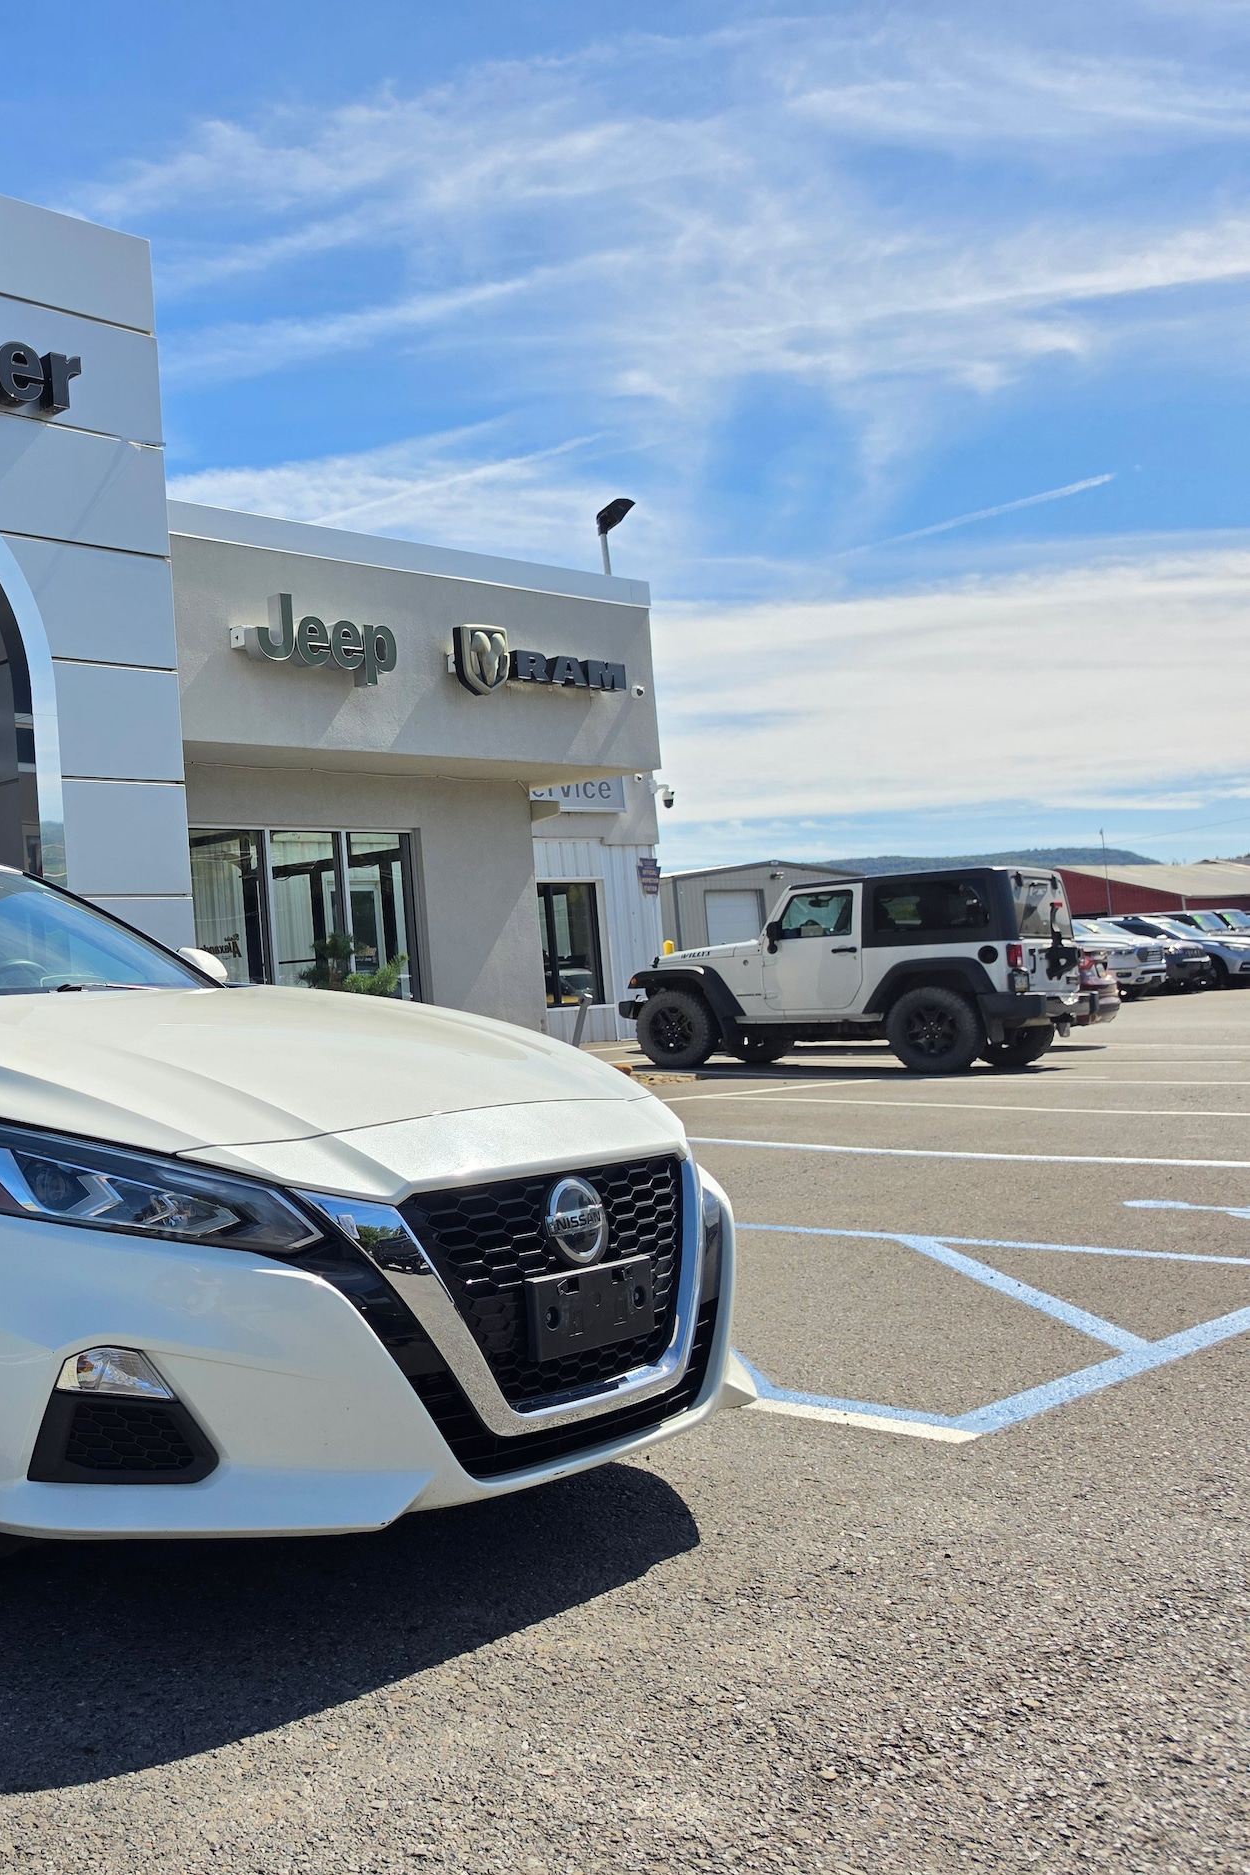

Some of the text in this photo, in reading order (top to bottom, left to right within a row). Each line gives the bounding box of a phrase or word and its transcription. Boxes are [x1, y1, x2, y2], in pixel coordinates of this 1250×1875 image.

[251, 592, 396, 688] Jeep
[509, 650, 626, 692] RAM
[680, 950, 711, 960] WILLYS
[556, 1211, 601, 1230] NISSAN
